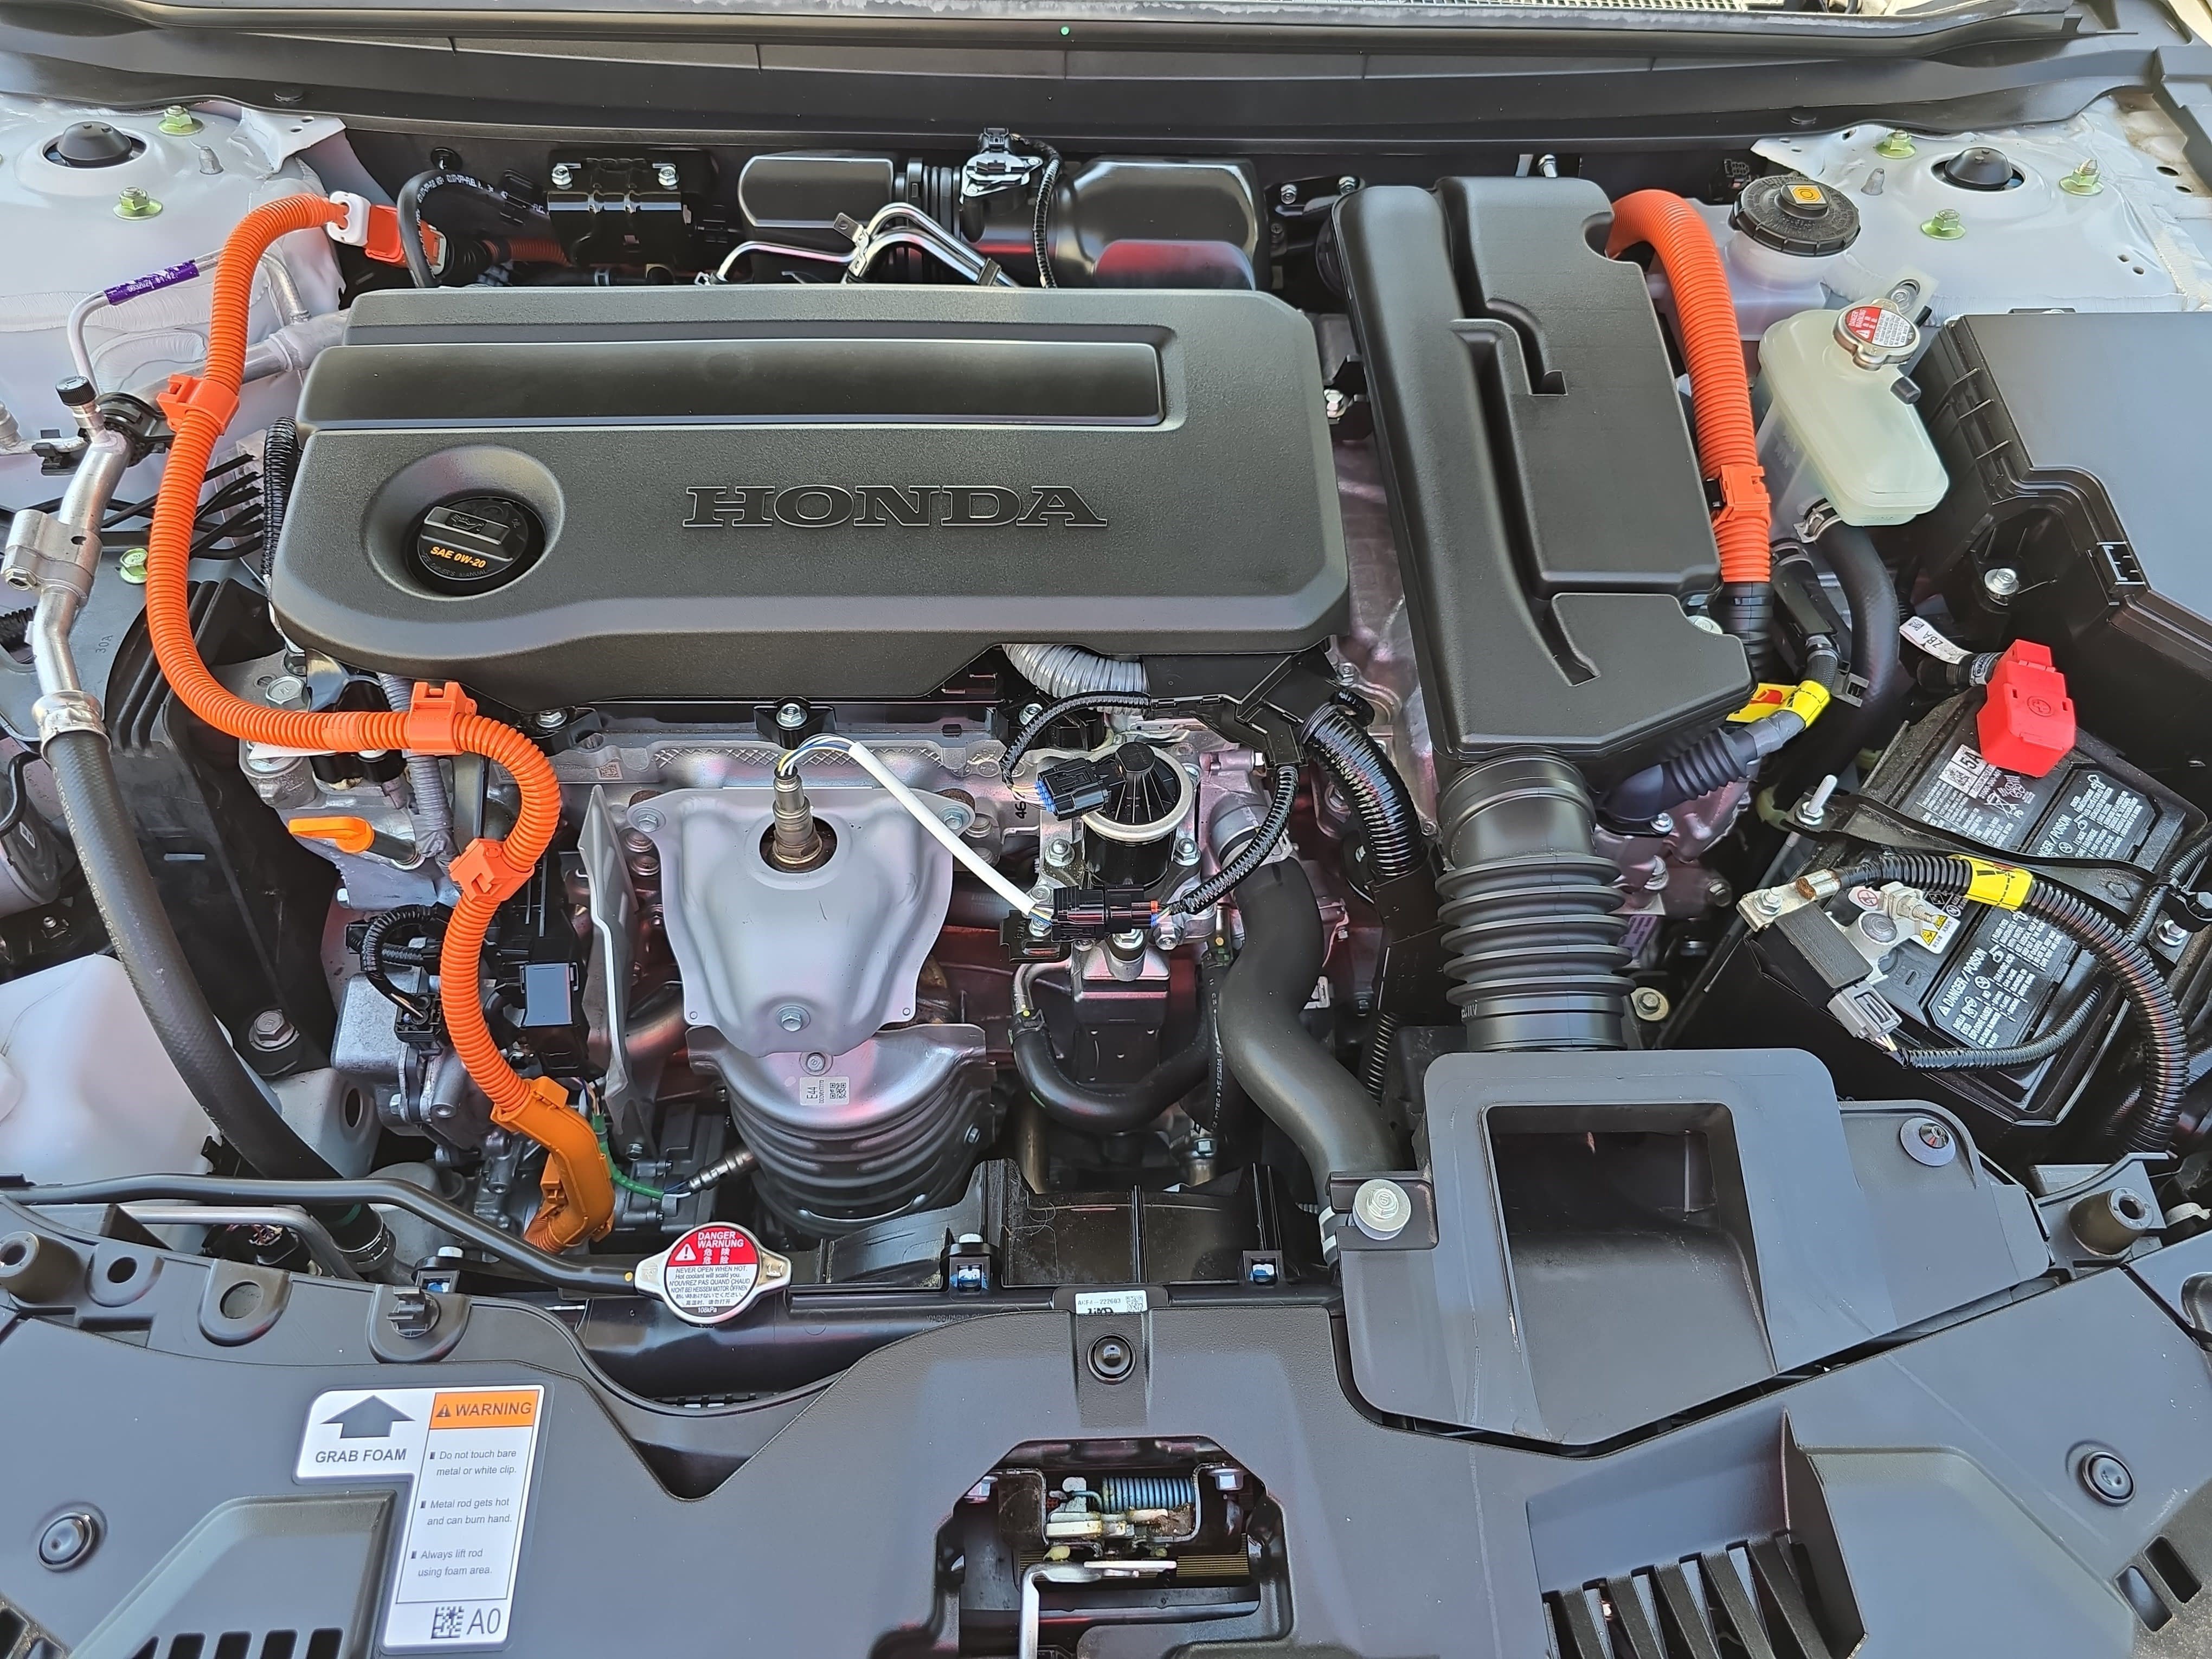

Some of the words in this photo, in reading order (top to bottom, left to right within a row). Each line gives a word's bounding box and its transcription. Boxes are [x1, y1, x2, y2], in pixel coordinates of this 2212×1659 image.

[682, 485, 1108, 527] HONDA
[430, 546, 454, 559] SAE
[454, 554, 486, 568] 0W-20
[1922, 631, 1944, 649] ZBA
[1959, 748, 1982, 770] 5A
[1973, 777, 1985, 792] GROUP
[2014, 808, 2024, 819] Pb
[1982, 989, 1992, 999] NO
[807, 1086, 818, 1098] E44
[698, 1239, 744, 1249] WARNUNG
[456, 1402, 532, 1417] WARNING
[316, 1450, 358, 1463] GRAB
[363, 1448, 407, 1462] FOAM
[439, 1450, 452, 1460] Do
[455, 1451, 468, 1459] not
[471, 1450, 494, 1459] touch
[497, 1449, 517, 1458] bare
[436, 1466, 461, 1476] metal
[475, 1465, 498, 1475] white
[500, 1465, 517, 1476] clip.
[430, 1499, 455, 1509] Metal
[457, 1499, 471, 1508] rod
[473, 1499, 493, 1510] gets
[495, 1498, 509, 1507] hot
[427, 1515, 444, 1525] and
[465, 1515, 485, 1525] burn
[487, 1514, 512, 1524] hand.
[421, 1549, 453, 1560] Always
[455, 1549, 466, 1558] lift
[468, 1548, 483, 1558] rod
[418, 1566, 442, 1578] using
[445, 1566, 467, 1576] foam
[469, 1566, 492, 1575] area.
[467, 1608, 501, 1635] A0
